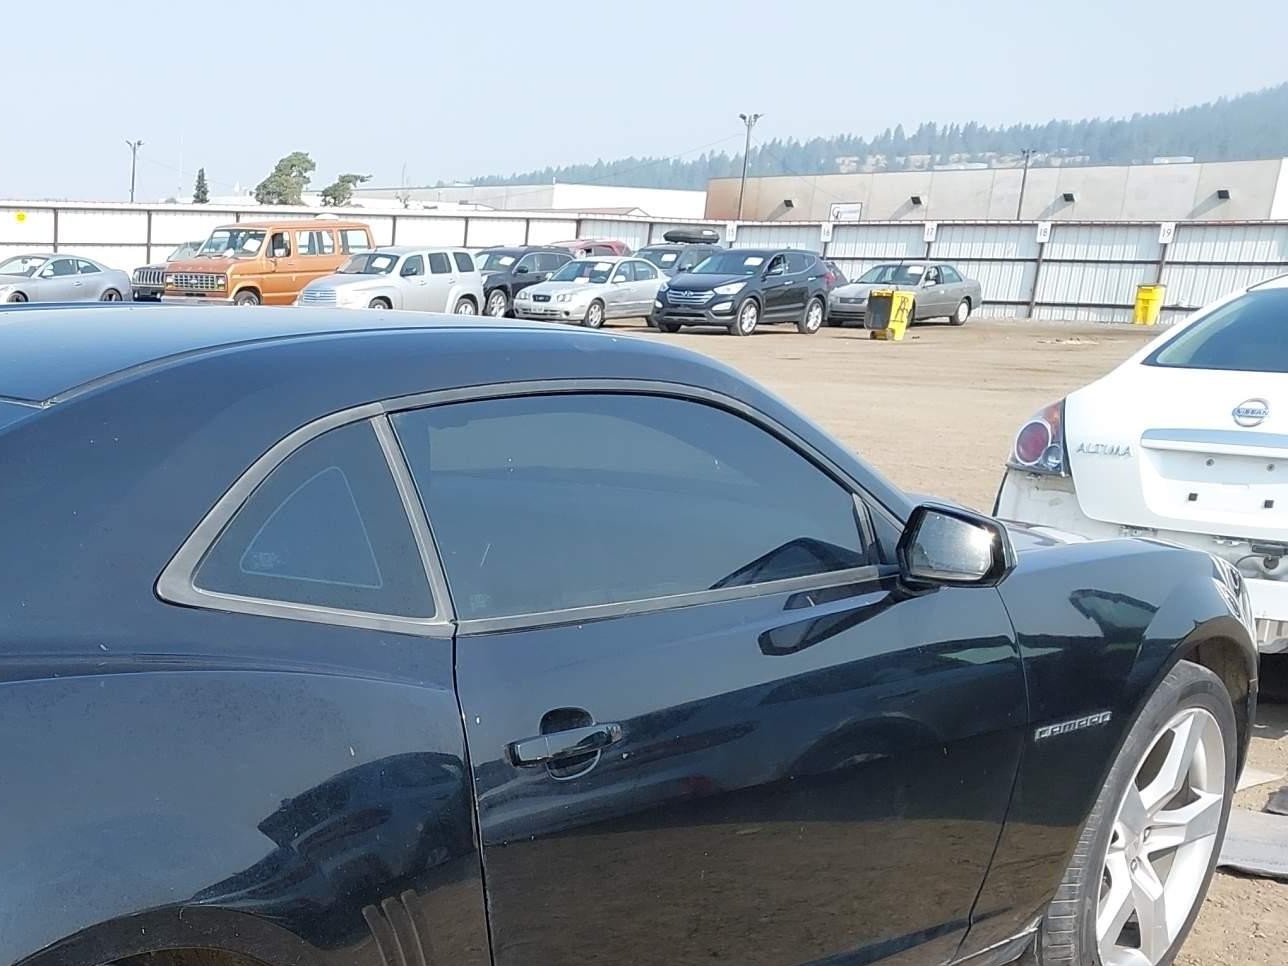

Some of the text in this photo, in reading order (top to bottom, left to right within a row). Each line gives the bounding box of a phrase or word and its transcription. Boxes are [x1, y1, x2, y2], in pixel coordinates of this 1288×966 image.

[1162, 227, 1172, 238] 19
[1237, 407, 1270, 417] NISSAN
[1075, 442, 1134, 457] ALTIMA
